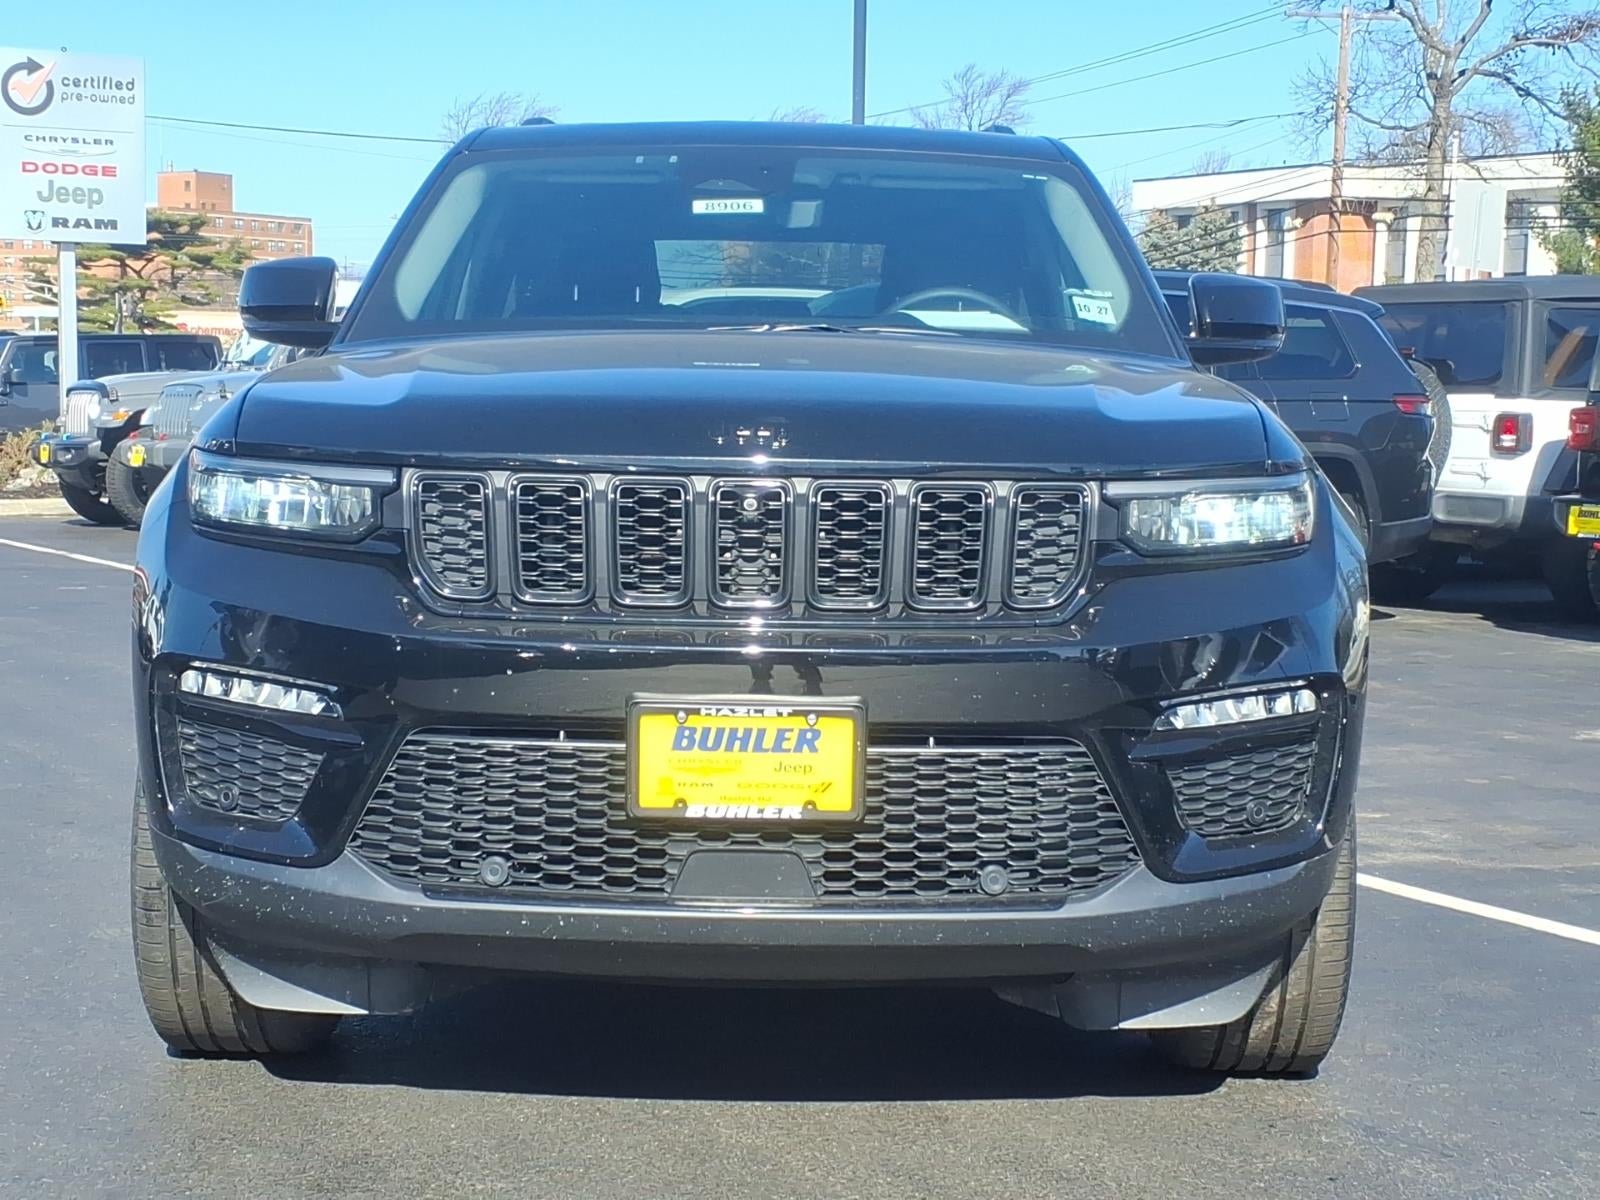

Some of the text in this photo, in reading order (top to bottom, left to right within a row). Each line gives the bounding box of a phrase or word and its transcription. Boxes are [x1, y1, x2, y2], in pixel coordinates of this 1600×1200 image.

[61, 76, 135, 91] certified
[61, 90, 135, 105] pre-owned
[24, 134, 115, 146] CHRYSLER
[22, 162, 117, 178] DODGE
[37, 180, 104, 209] Jeep
[704, 201, 754, 212] 8906
[51, 217, 118, 230] RAM
[1077, 303, 1108, 316] 10 27
[700, 706, 793, 717] HAZLET
[671, 725, 822, 753] BUHLER
[773, 761, 813, 775] Jeep
[684, 804, 803, 819] BUHLER
